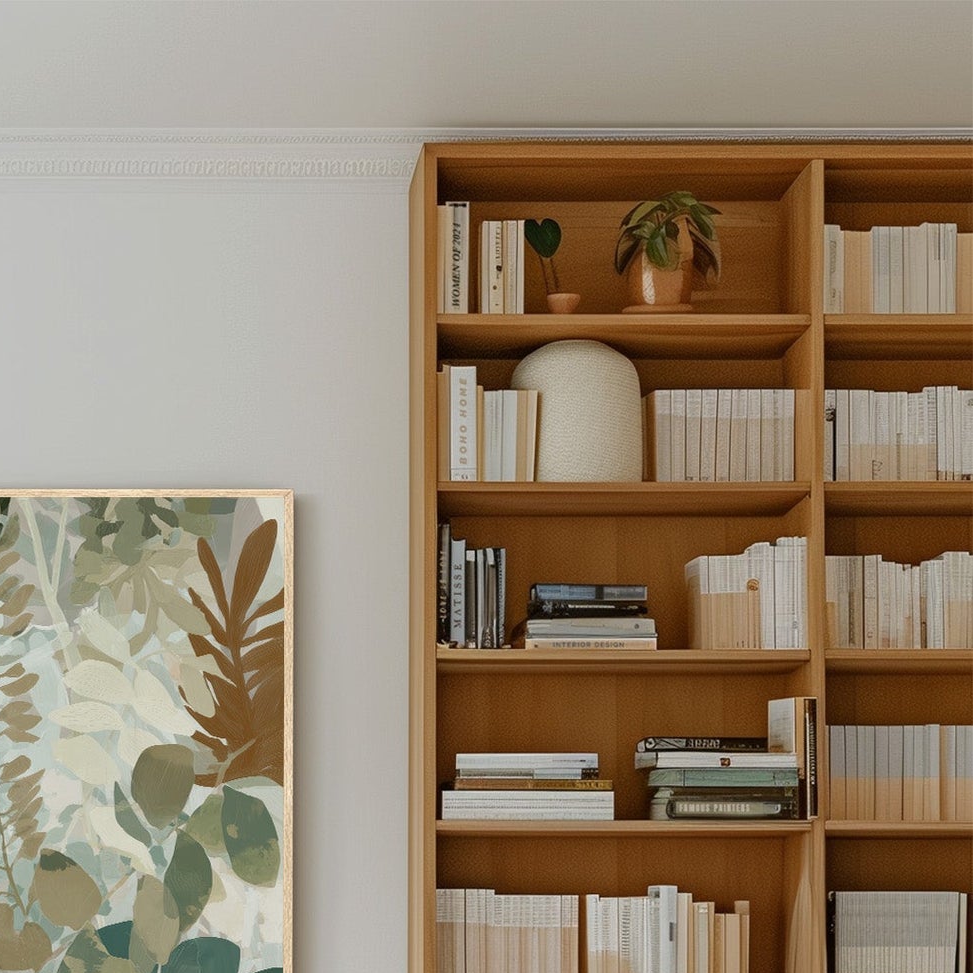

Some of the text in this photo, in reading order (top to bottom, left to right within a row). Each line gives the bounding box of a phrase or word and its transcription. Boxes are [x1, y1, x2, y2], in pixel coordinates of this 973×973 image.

[451, 222, 462, 307] WOMEN OF 2024
[459, 377, 467, 465] BOHO HOME
[453, 563, 462, 629] MATISSE
[678, 803, 750, 812] FAMOUS PAINTERS
